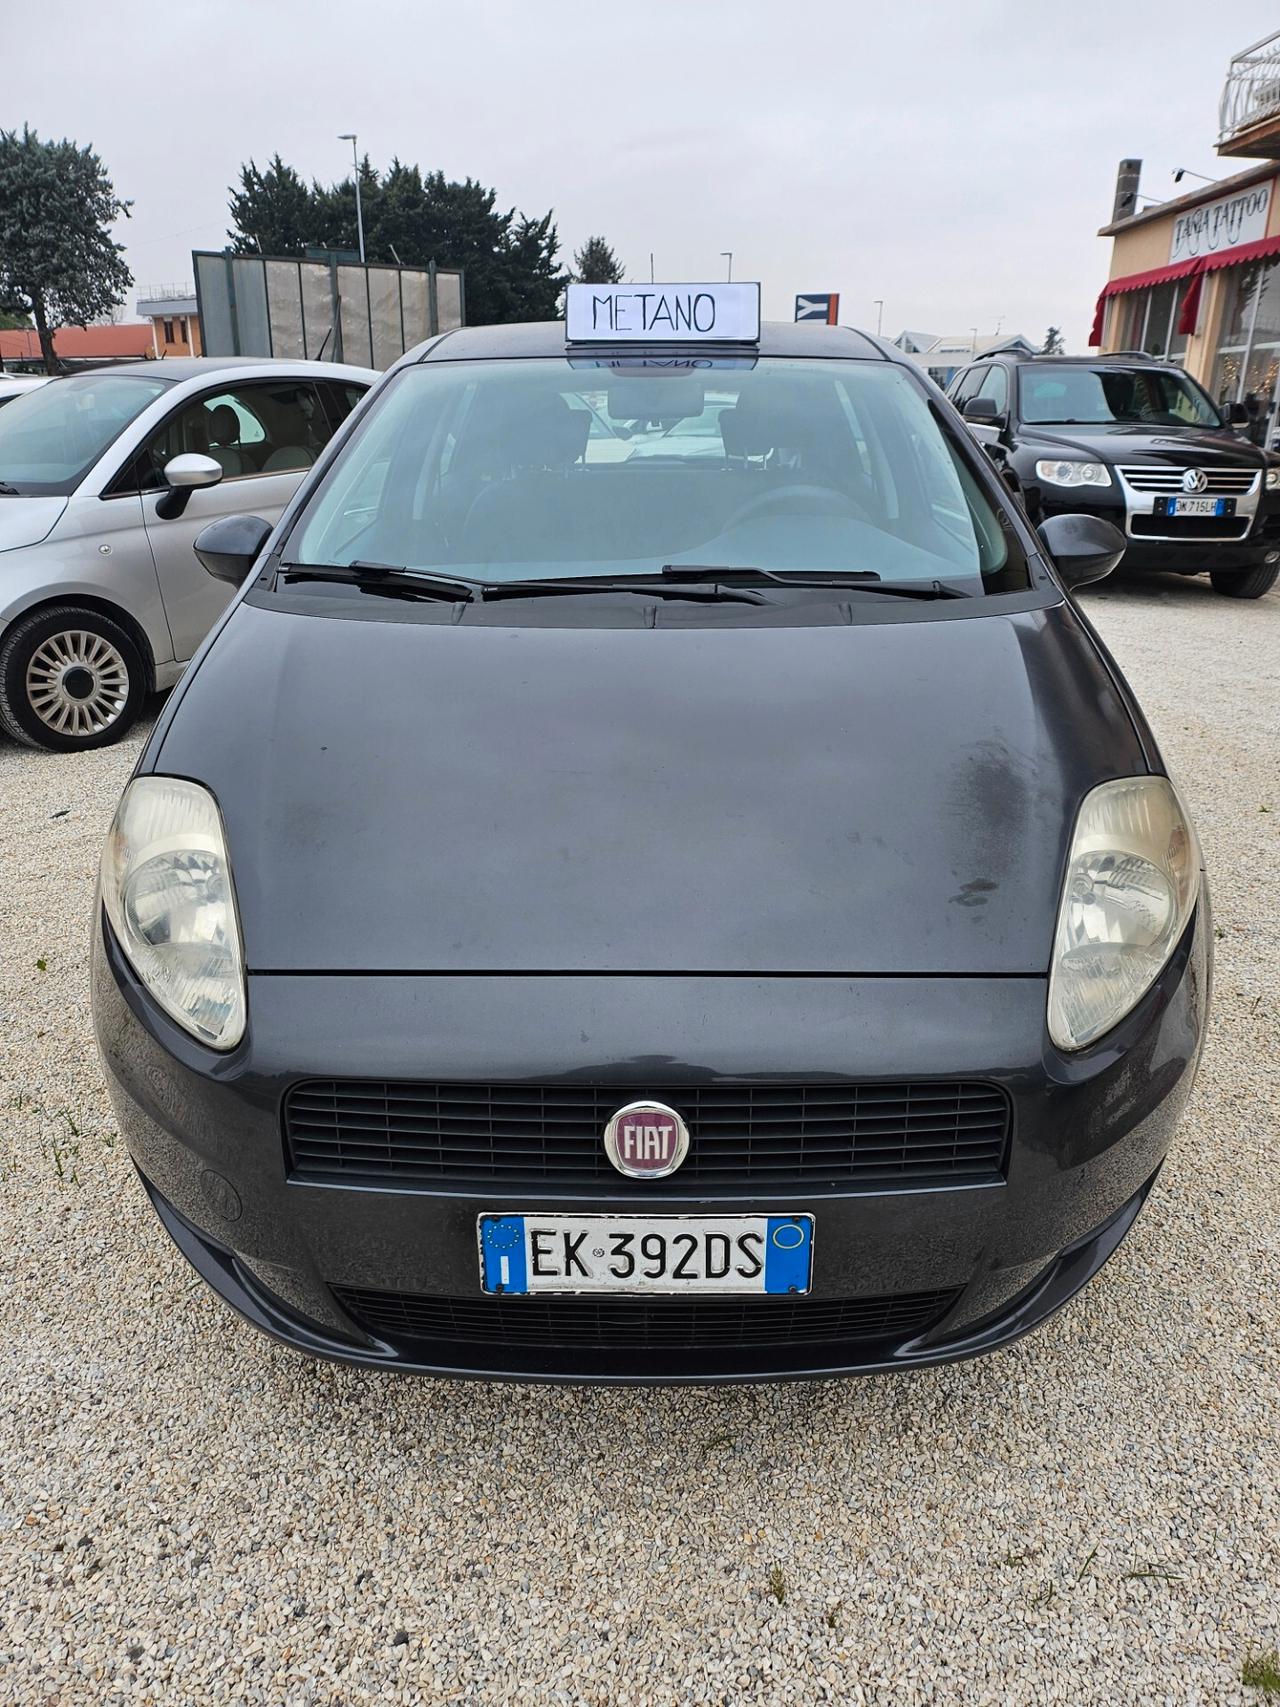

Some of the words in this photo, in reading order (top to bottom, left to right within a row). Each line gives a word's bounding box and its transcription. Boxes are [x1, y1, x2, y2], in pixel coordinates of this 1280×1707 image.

[1214, 189, 1268, 244] TATTOO
[592, 293, 716, 332] METANO
[623, 1125, 673, 1160] FIAT
[530, 1228, 592, 1278] EK
[607, 1230, 764, 1280] 392DS
